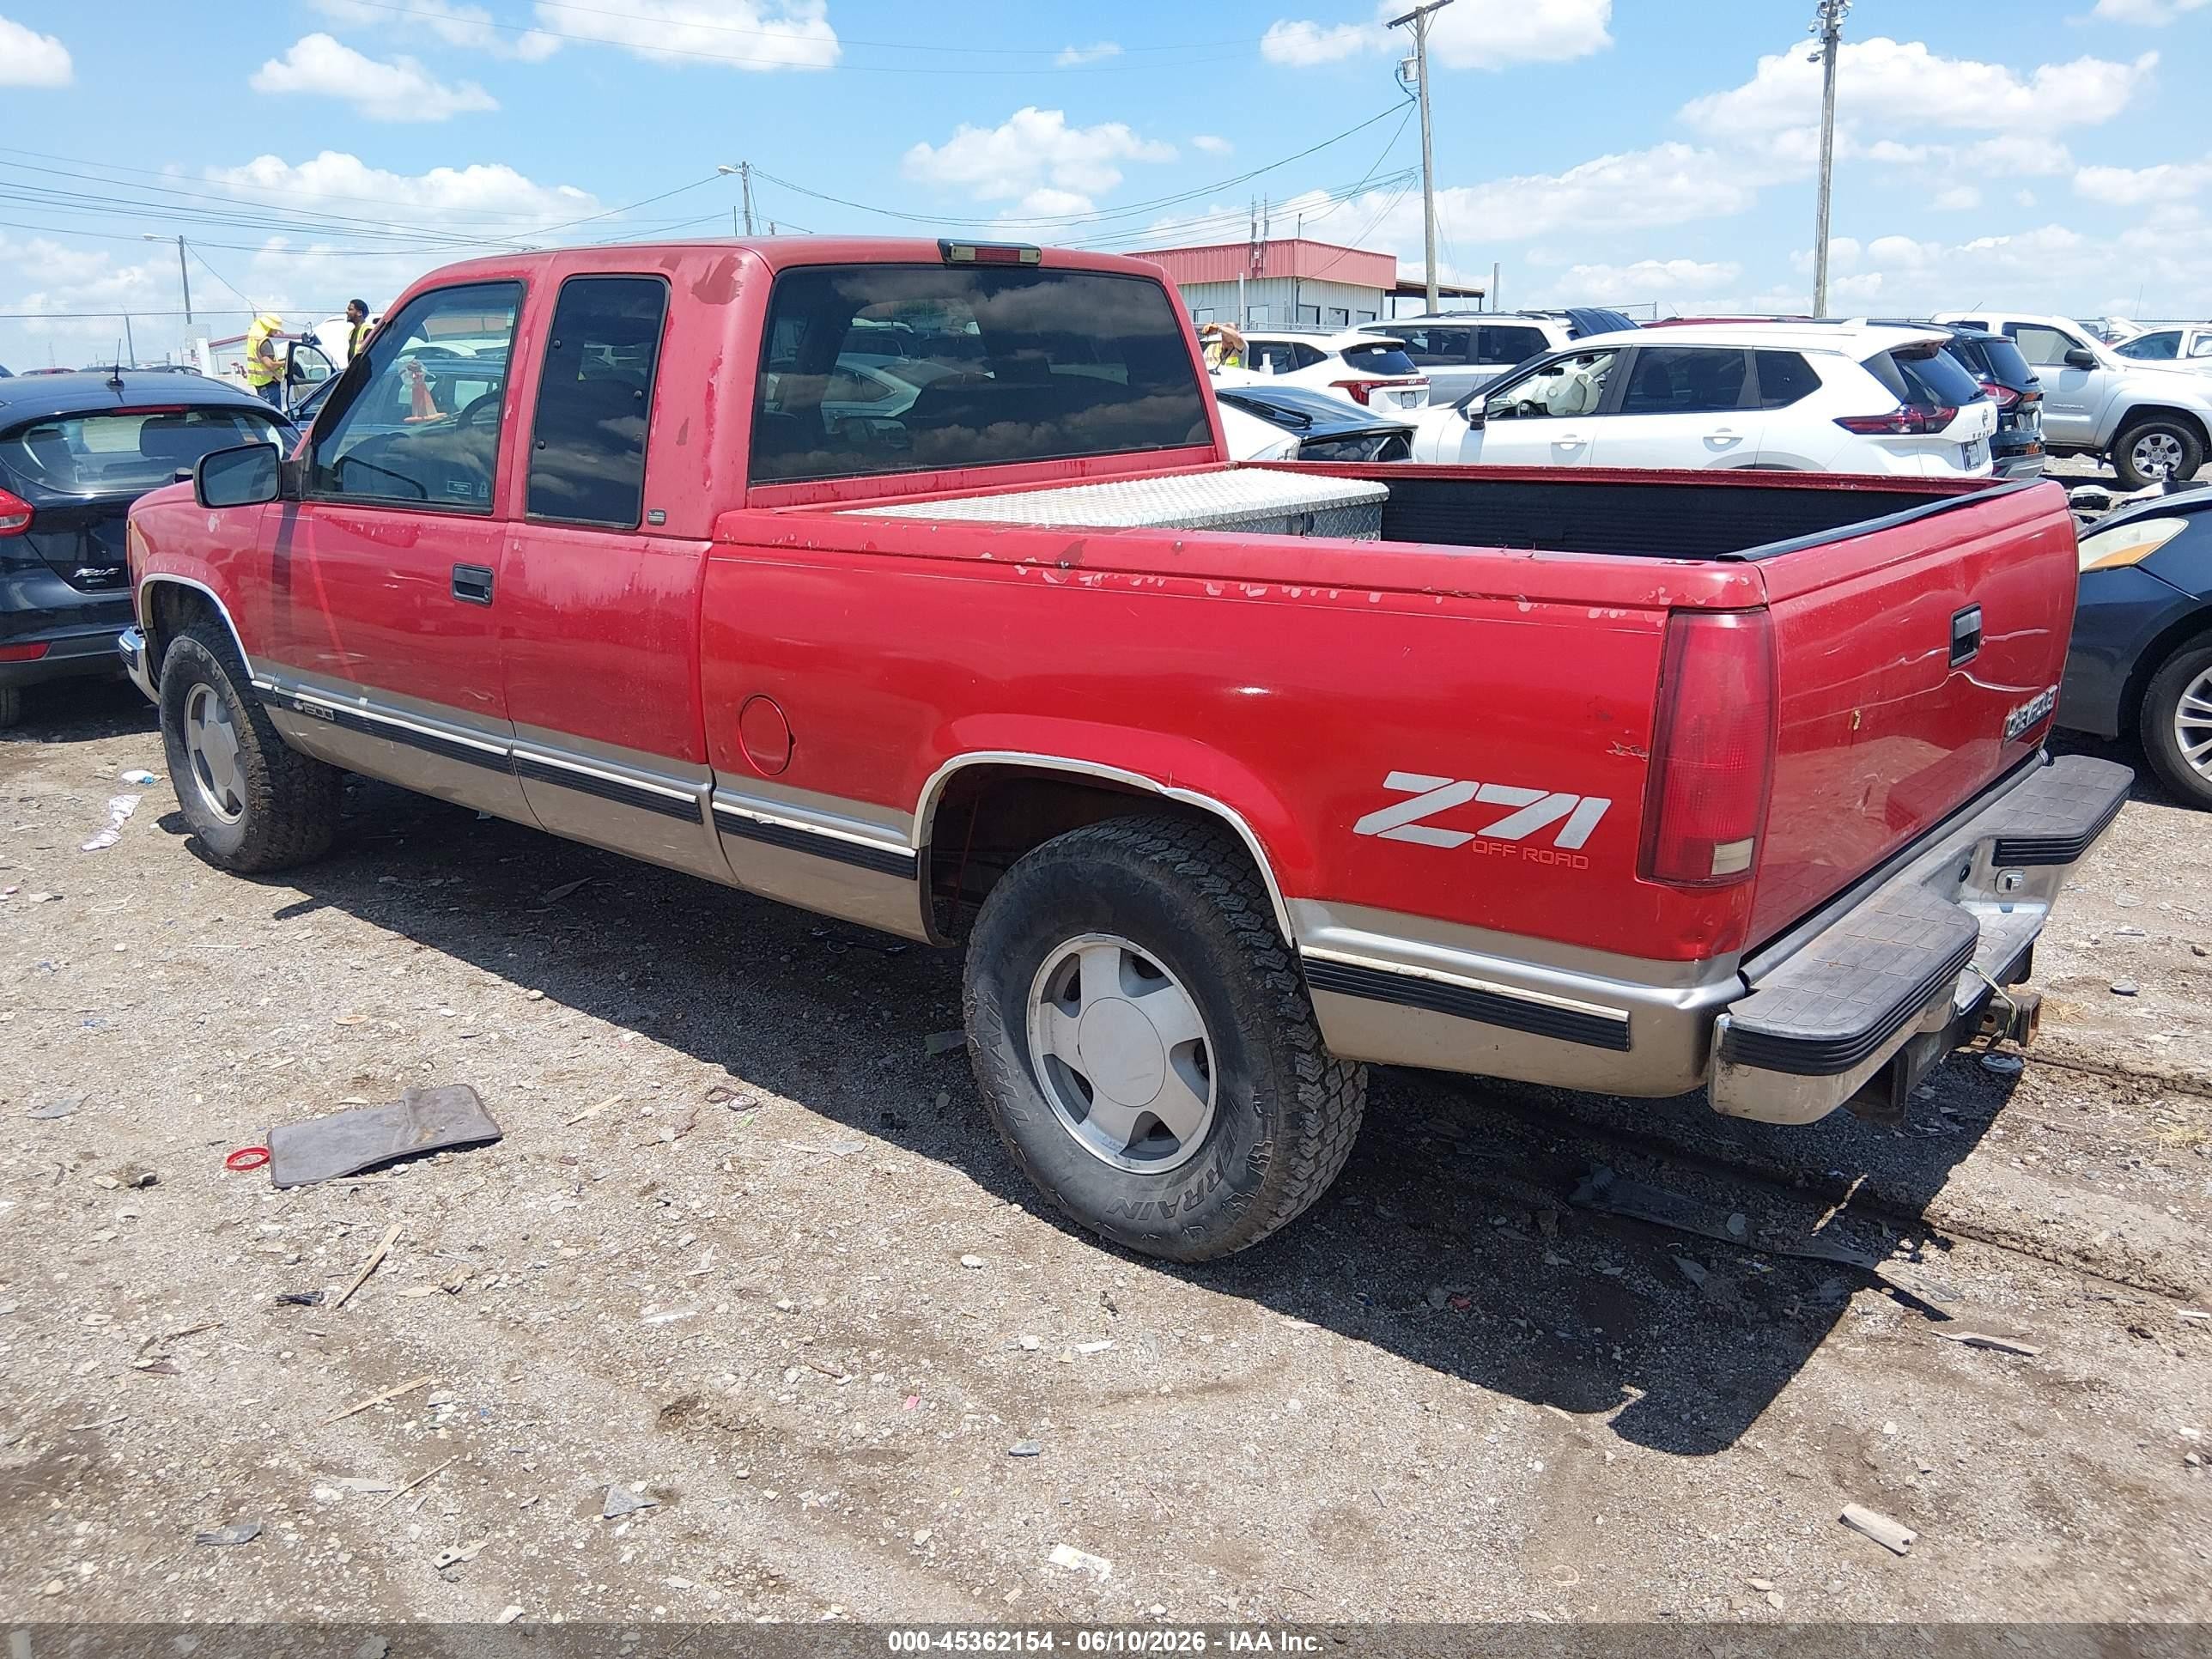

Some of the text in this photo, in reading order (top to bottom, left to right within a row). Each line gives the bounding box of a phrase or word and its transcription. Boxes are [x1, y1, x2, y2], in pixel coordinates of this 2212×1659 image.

[1352, 770, 1613, 850] Z71
[1472, 840, 1589, 870] OFF ROAD
